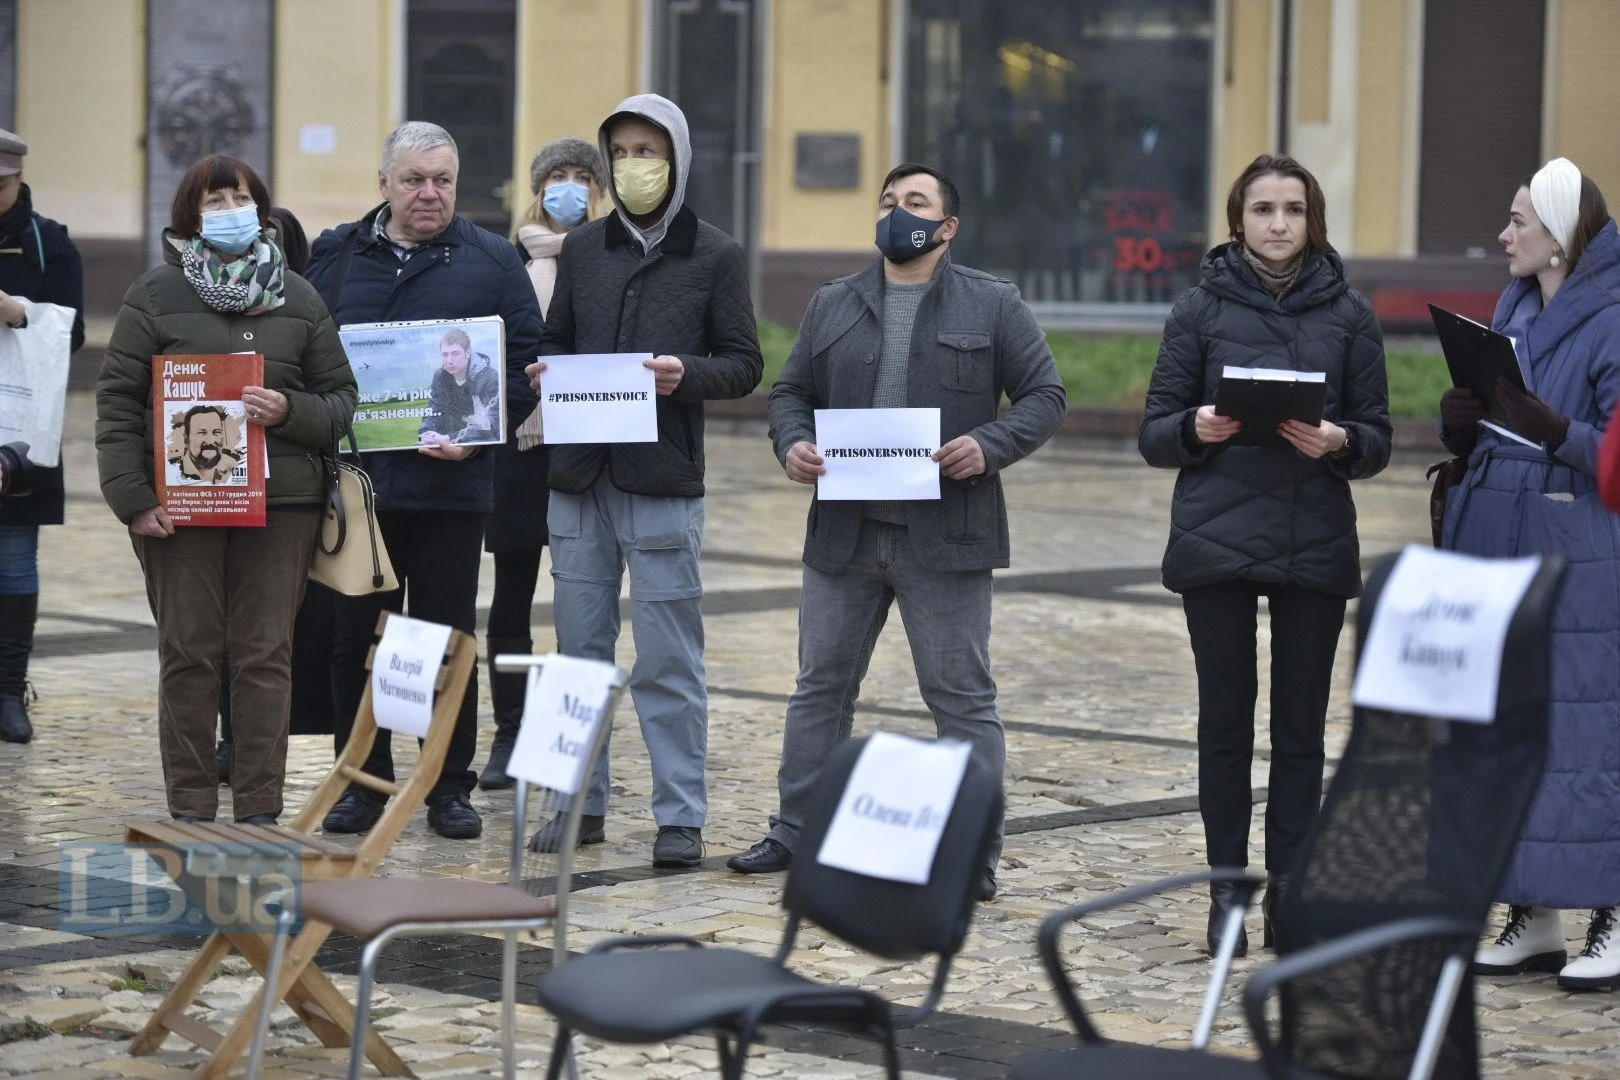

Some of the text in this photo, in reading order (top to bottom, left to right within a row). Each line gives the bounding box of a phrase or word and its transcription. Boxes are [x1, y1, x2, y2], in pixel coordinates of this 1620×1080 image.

[163, 360, 206, 378] Денис
[163, 378, 206, 401] Кашук
[410, 388, 433, 402] рік
[548, 391, 648, 403] #PRISONERSVOICE
[824, 447, 932, 458] #PRISONERSVOICE
[200, 490, 213, 498] ФСБ
[218, 490, 225, 498] 17
[226, 491, 247, 499] грудня
[248, 490, 263, 498] 2019
[388, 653, 425, 680] Валерій
[378, 677, 428, 706] Матюшенко
[853, 793, 913, 828] Олена
